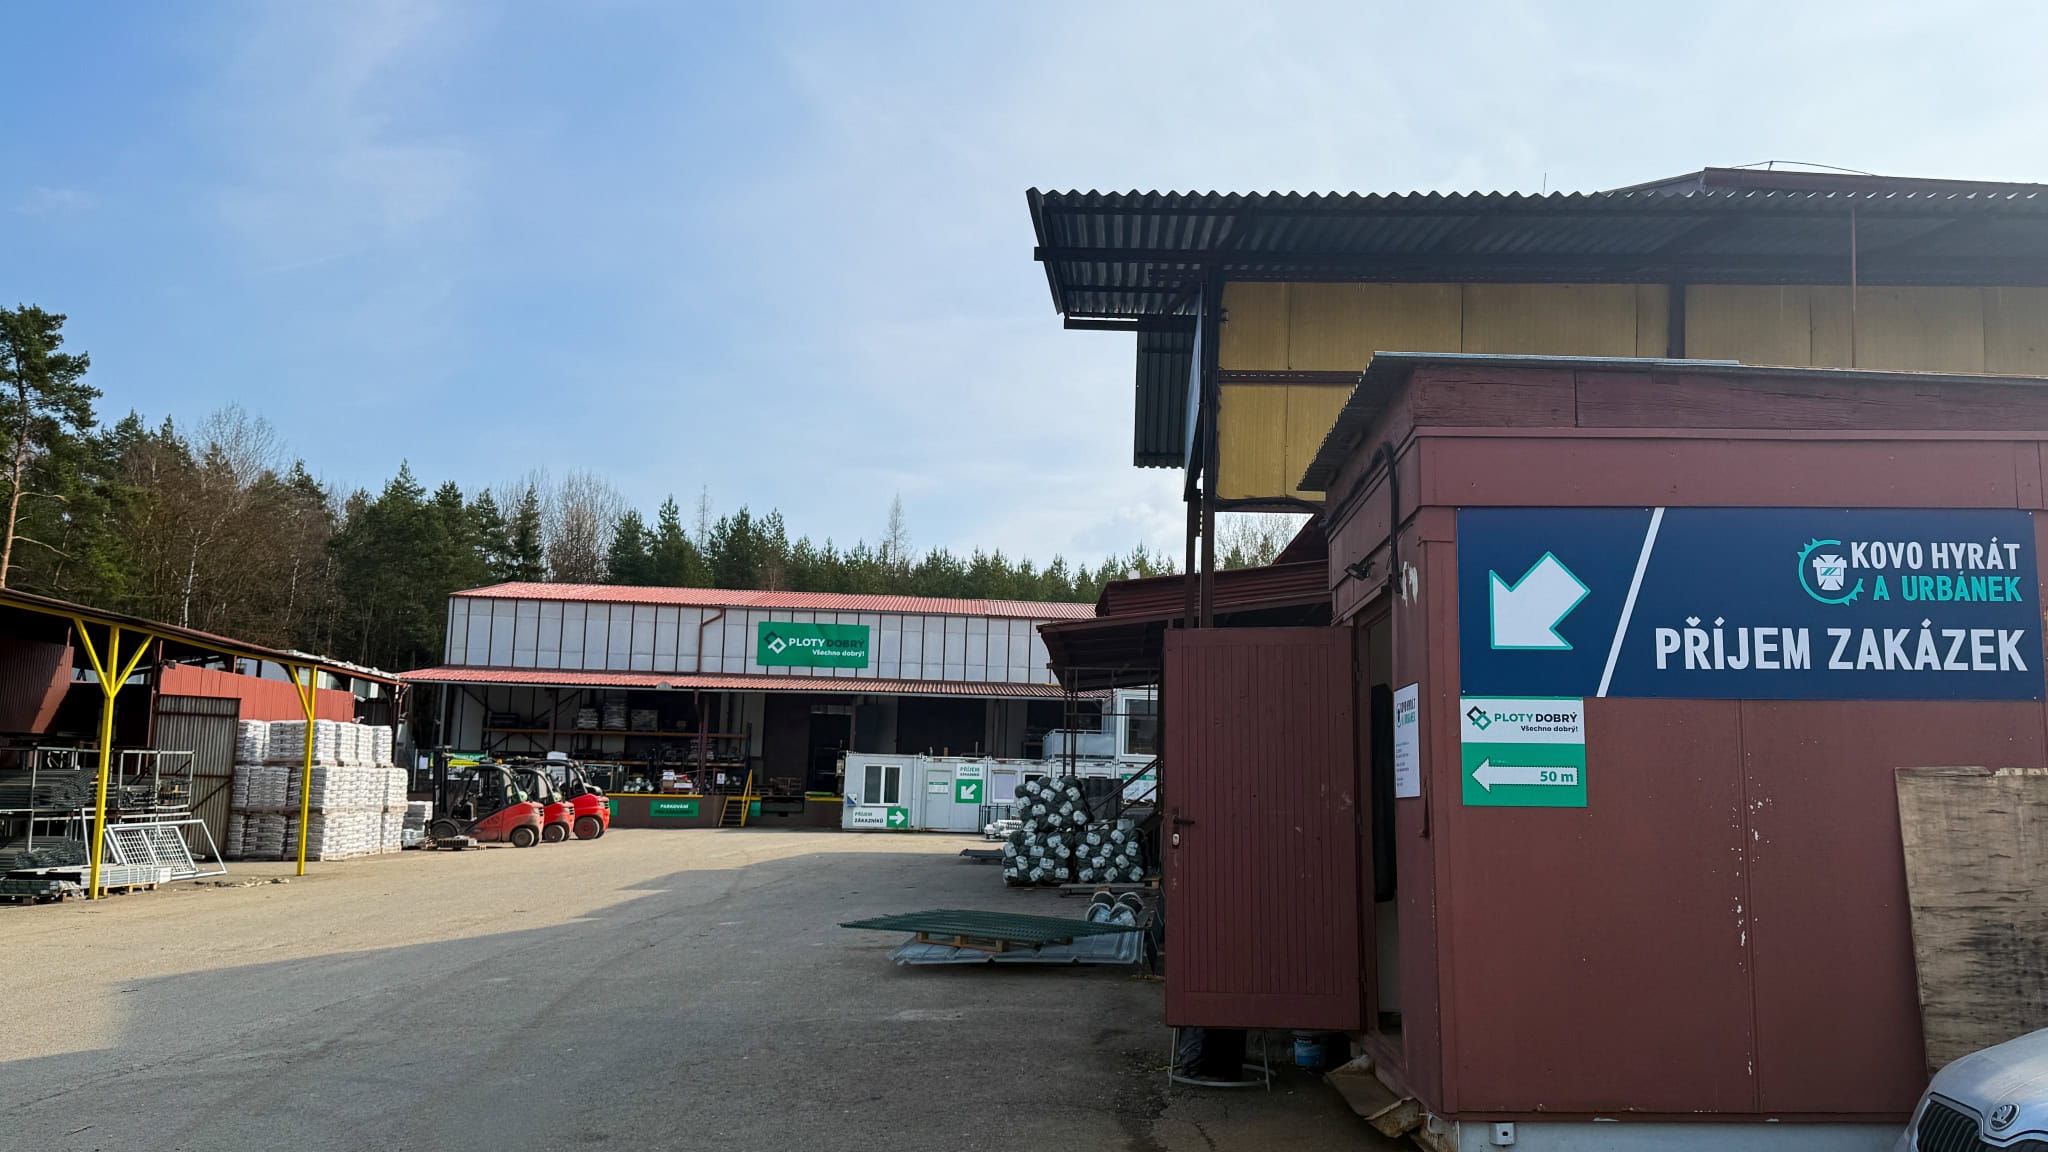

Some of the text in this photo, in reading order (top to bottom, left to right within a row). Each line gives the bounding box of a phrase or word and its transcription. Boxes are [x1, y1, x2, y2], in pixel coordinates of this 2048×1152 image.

[1851, 537, 2021, 570] KOVO HYRÁT
[1873, 571, 2023, 602] A URBÁNEK
[788, 638, 865, 648] PLOTY DOBRÝ
[1655, 616, 2029, 671] PŘÍJEM ZAKÁZEK
[842, 650, 865, 658] dobrý!
[1494, 711, 1578, 723] PLOTY DOBRÝ
[1520, 724, 1578, 733] Všechno dobrý!
[1540, 770, 1574, 783] 50 m
